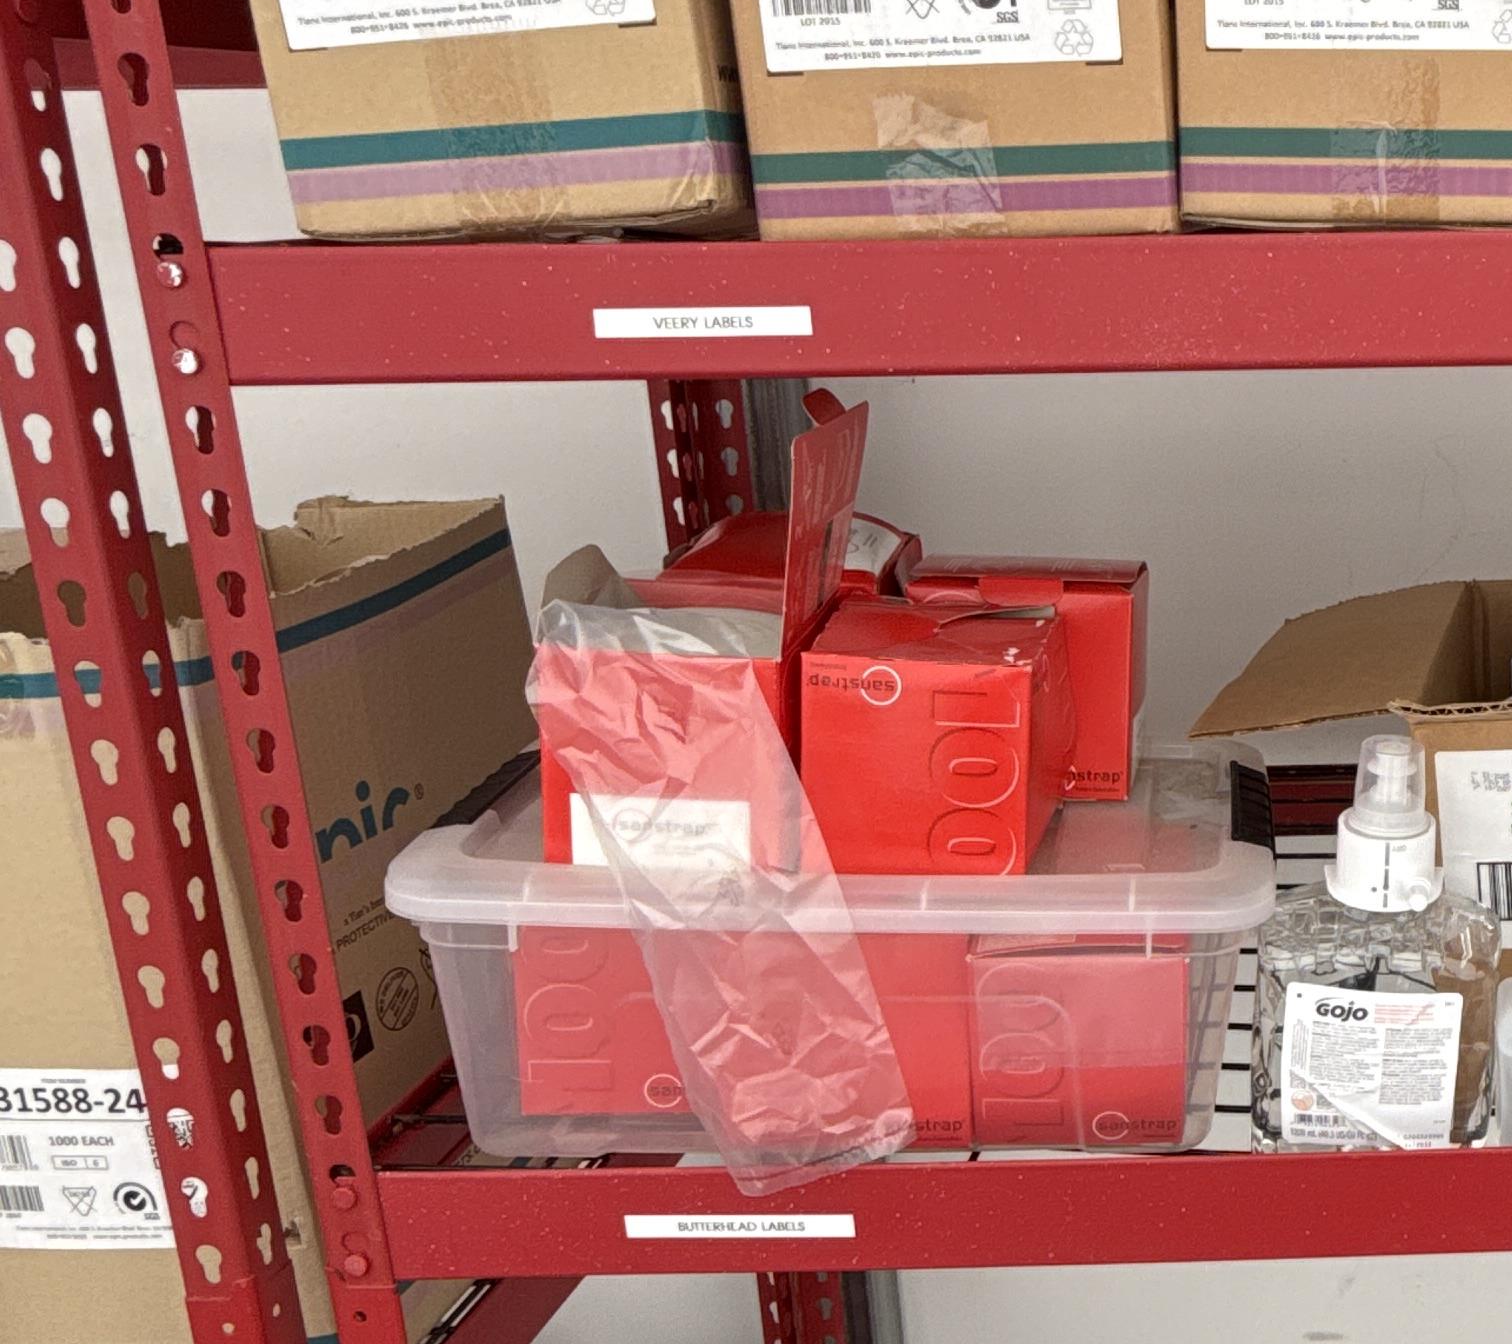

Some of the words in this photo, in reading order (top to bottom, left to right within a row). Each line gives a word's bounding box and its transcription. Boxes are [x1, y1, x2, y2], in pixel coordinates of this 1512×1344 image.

[1438, 0, 1458, 9] SGS
[800, 18, 815, 26] LOT
[997, 11, 1018, 23] SGS
[653, 316, 698, 329] VEERY
[705, 316, 753, 328] LABELS
[808, 673, 896, 691] sanstrap
[49, 1136, 78, 1146] 1000
[82, 1136, 115, 1146] EACH
[678, 1221, 757, 1232] BUTTERHEAD
[762, 1221, 806, 1232] LABELS
